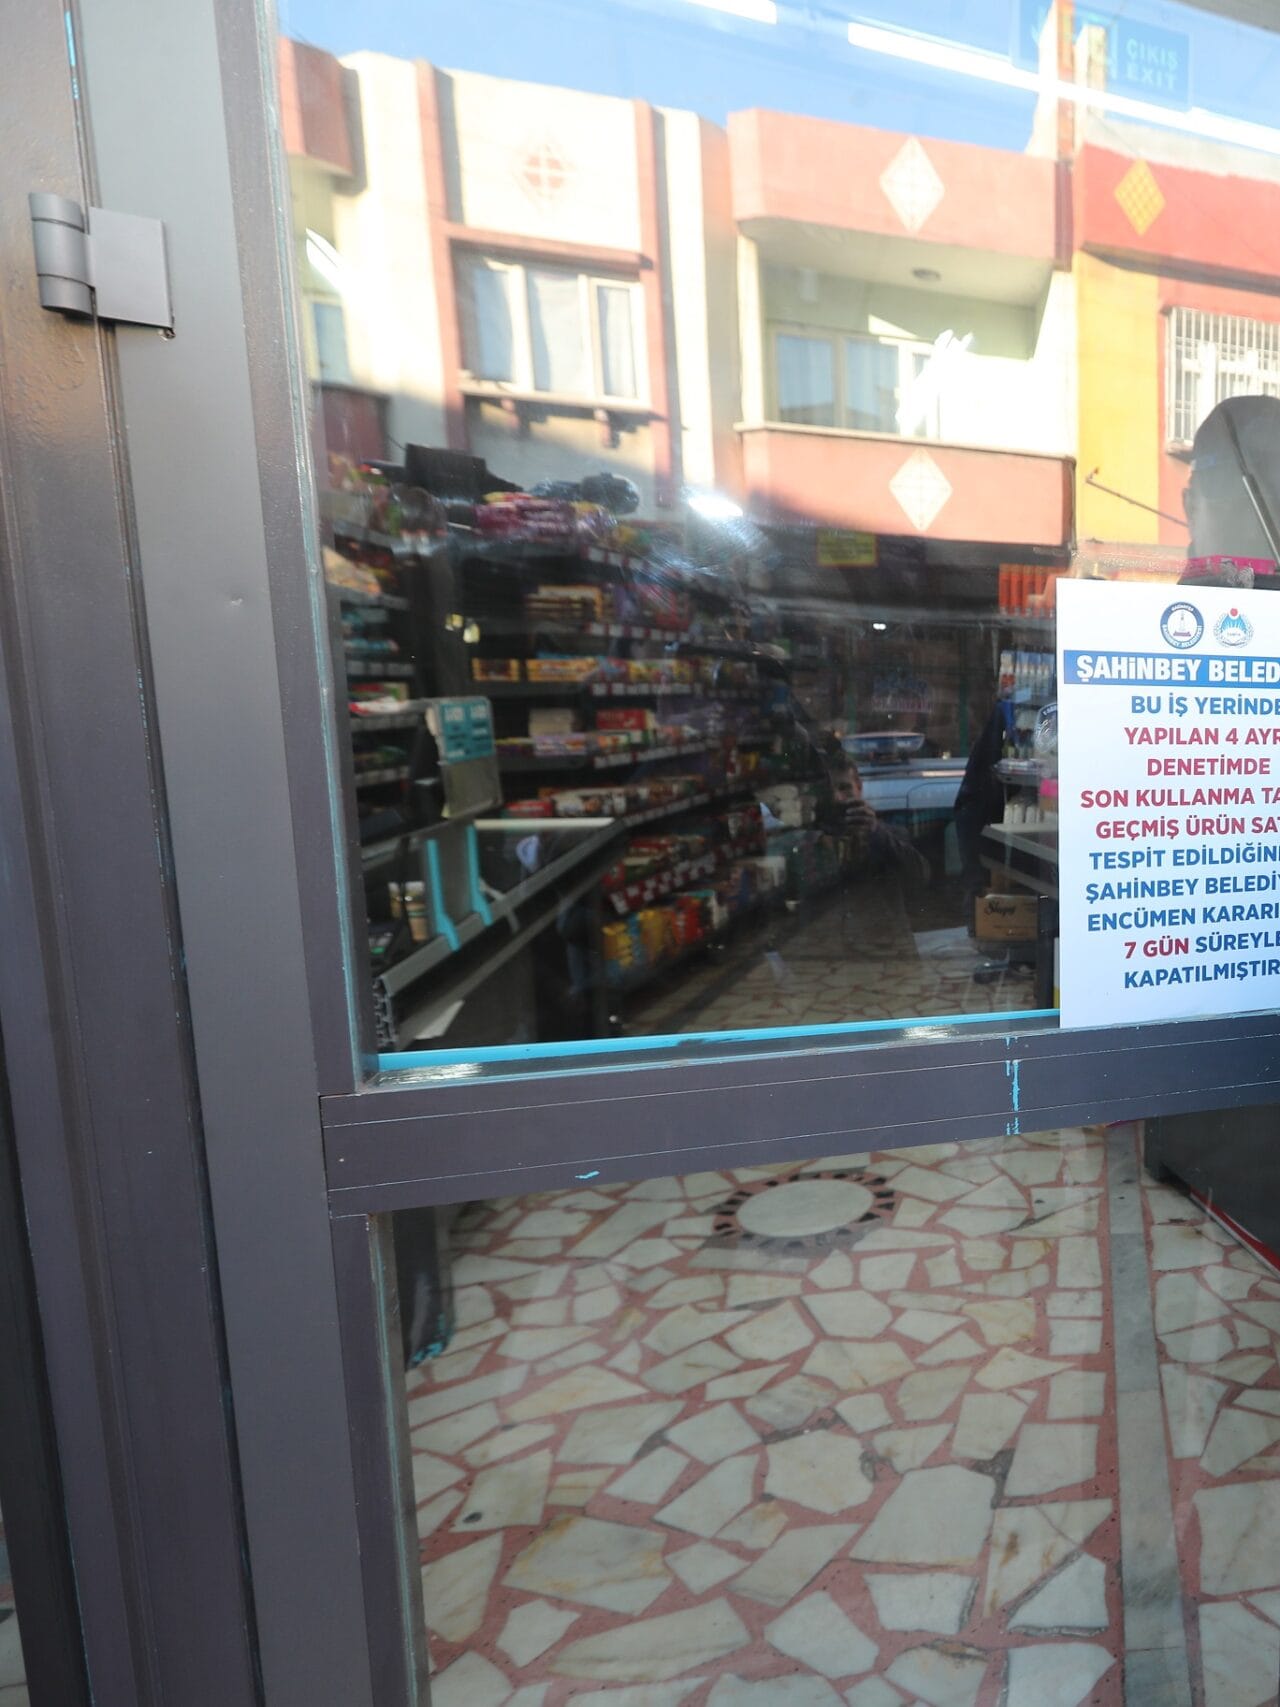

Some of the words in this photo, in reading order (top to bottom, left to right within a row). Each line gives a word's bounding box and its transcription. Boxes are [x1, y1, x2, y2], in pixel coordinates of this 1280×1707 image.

[1126, 63, 1179, 91] EXIT
[1077, 655, 1202, 683] ŞAHİNBEY
[1131, 695, 1161, 714] BU
[1168, 693, 1188, 717] İŞ
[1124, 727, 1219, 746] YAPILAN
[1225, 727, 1239, 745] 4
[1147, 755, 1271, 777] DENETİMDE
[1080, 789, 1129, 809] SON
[1136, 788, 1255, 807] KULLANMA
[1096, 816, 1180, 840] GEÇMİŞ
[1186, 814, 1246, 836] ÜRÜN
[1089, 847, 1166, 871] TESPİT
[1086, 877, 1200, 904] ŞAHİNBEY
[1087, 907, 1196, 932] ENCÜMEN
[1124, 941, 1137, 960] 7
[1143, 935, 1190, 958] GÜN
